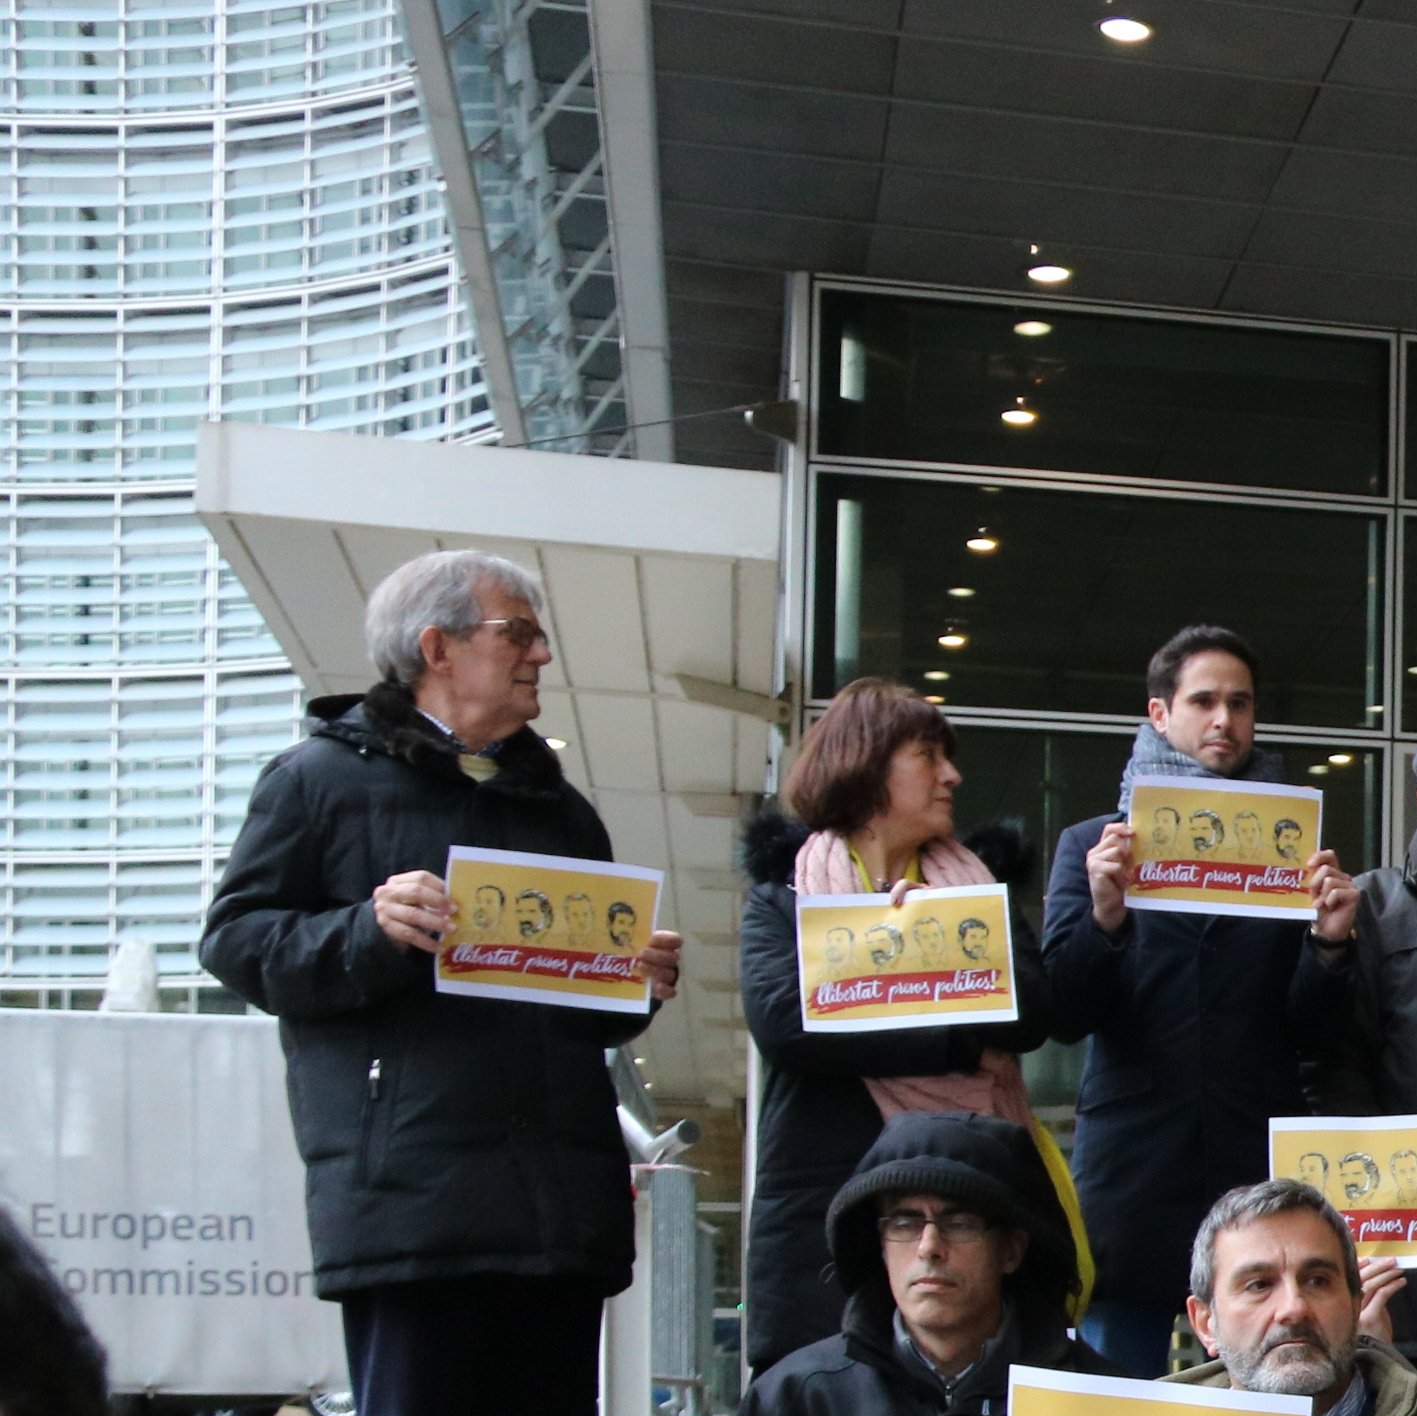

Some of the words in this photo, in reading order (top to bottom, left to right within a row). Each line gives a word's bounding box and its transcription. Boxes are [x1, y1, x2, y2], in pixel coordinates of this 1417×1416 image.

[1139, 860, 1200, 882] llibertat
[816, 979, 883, 1006] llibertat
[31, 1202, 255, 1250] European
[50, 1258, 318, 1297] ommission
